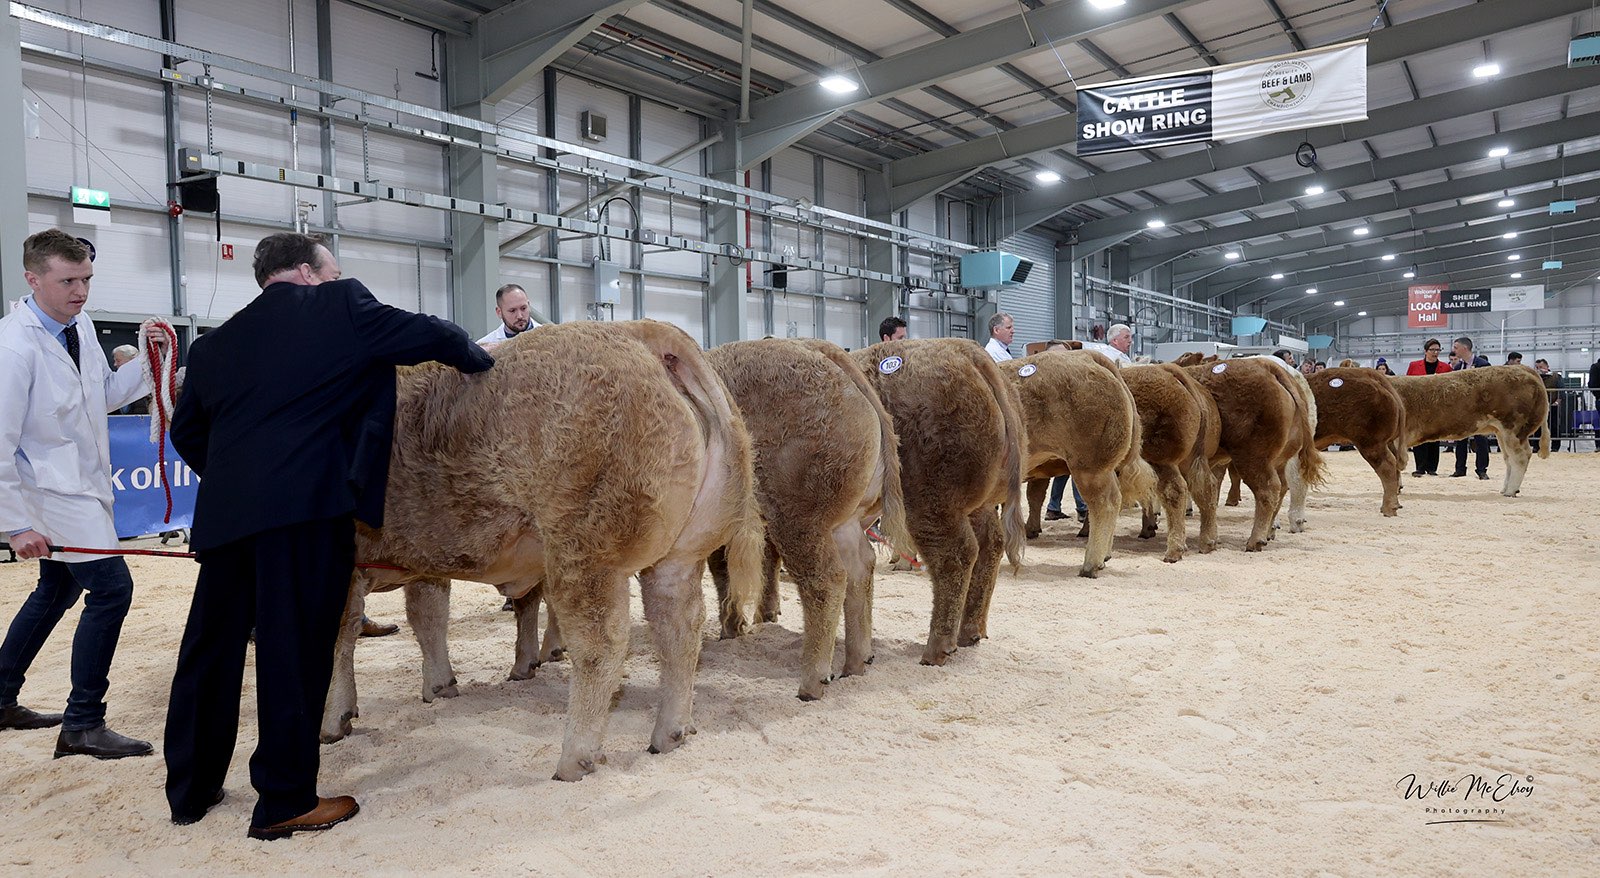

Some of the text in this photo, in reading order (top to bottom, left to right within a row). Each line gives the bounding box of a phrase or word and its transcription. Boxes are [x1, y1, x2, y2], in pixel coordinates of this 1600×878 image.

[1265, 69, 1273, 77] THE
[1274, 61, 1290, 69] ROYAL
[1261, 72, 1312, 89] BEEF & LAMB
[1102, 88, 1185, 115] CATTLE
[1266, 94, 1307, 109] CHAMPIONSHIPS
[1082, 108, 1207, 140] SHOW RING
[1418, 313, 1438, 322] Hall
[886, 361, 898, 370] 103
[130, 461, 168, 490] of
[174, 460, 201, 487] Ir
